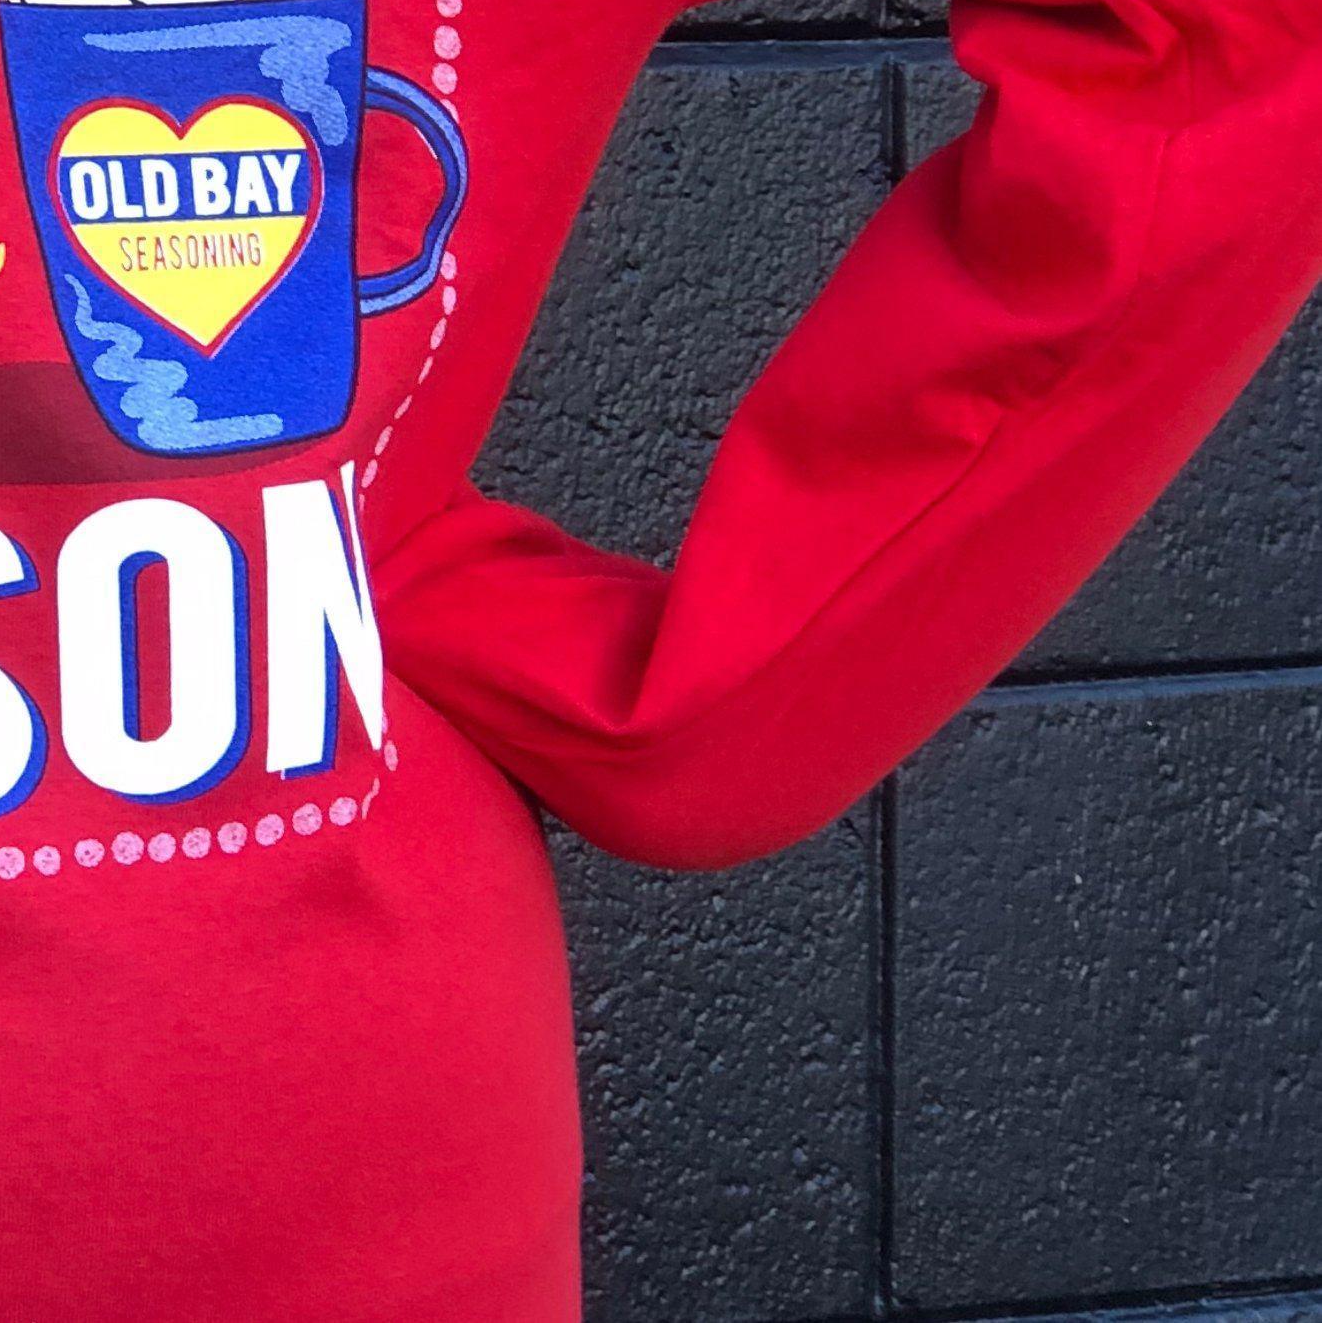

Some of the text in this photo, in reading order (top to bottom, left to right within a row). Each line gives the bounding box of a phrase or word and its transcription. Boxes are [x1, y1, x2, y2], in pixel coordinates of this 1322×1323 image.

[70, 155, 301, 220] OLD BAY
[120, 234, 261, 271] SEASONING
